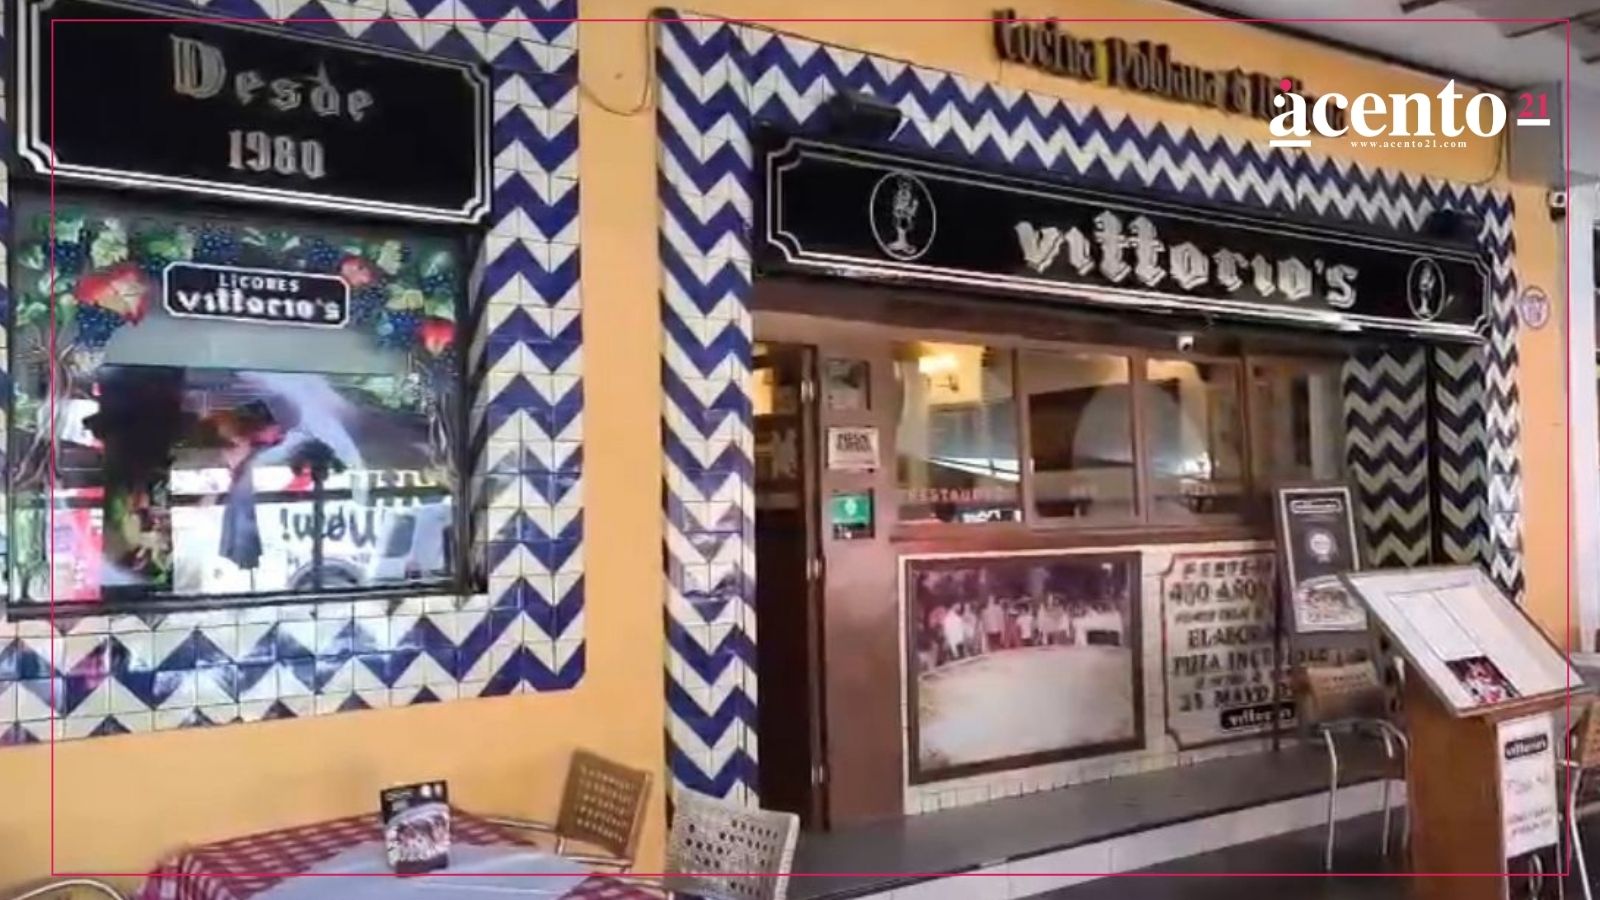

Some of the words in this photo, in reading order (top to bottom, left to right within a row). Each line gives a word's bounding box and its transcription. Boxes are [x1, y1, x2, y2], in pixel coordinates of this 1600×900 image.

[169, 33, 374, 122] Desde
[227, 129, 325, 180] 1980
[1013, 209, 1360, 309] vittorio's
[176, 288, 341, 321] vittorio's
